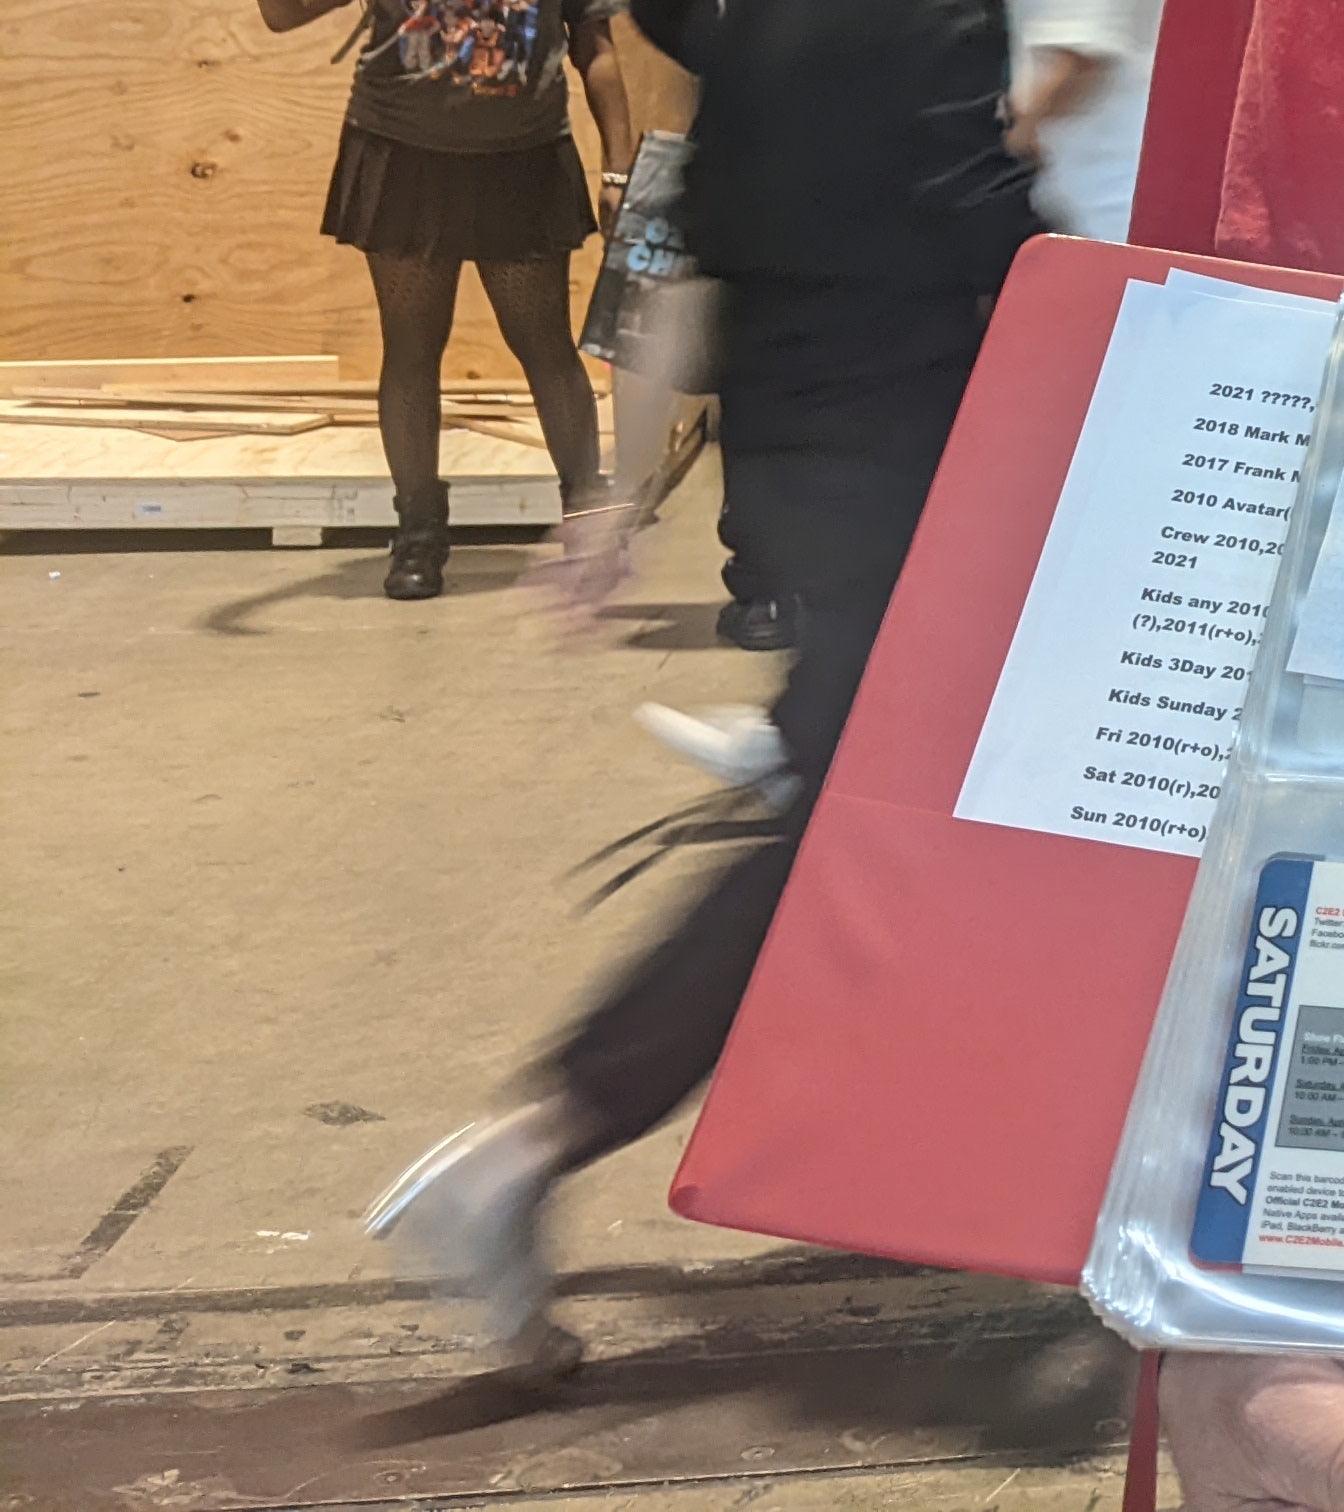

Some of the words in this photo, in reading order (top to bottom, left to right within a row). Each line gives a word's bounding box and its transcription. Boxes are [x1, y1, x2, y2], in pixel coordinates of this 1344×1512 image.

[1210, 383, 1254, 401] 2021
[1193, 418, 1240, 436] 2018
[1244, 426, 1290, 444] Mark
[1182, 454, 1229, 471] 2017
[1233, 461, 1287, 480] Frank
[1171, 489, 1218, 507] 2010
[1161, 526, 1210, 544] Crew
[1152, 551, 1198, 569] 2021
[1141, 588, 1183, 606] Kids
[1188, 597, 1223, 613] any
[1120, 650, 1163, 669] Kids
[1168, 657, 1217, 679] 3Day
[1108, 688, 1151, 707] Kids
[1156, 696, 1228, 721] Sunday
[1096, 727, 1123, 743] Fri
[1083, 766, 1117, 783] Sat
[1070, 806, 1108, 823] Sun
[1315, 906, 1341, 916] C2E2
[1210, 905, 1298, 1207] SATURDAY
